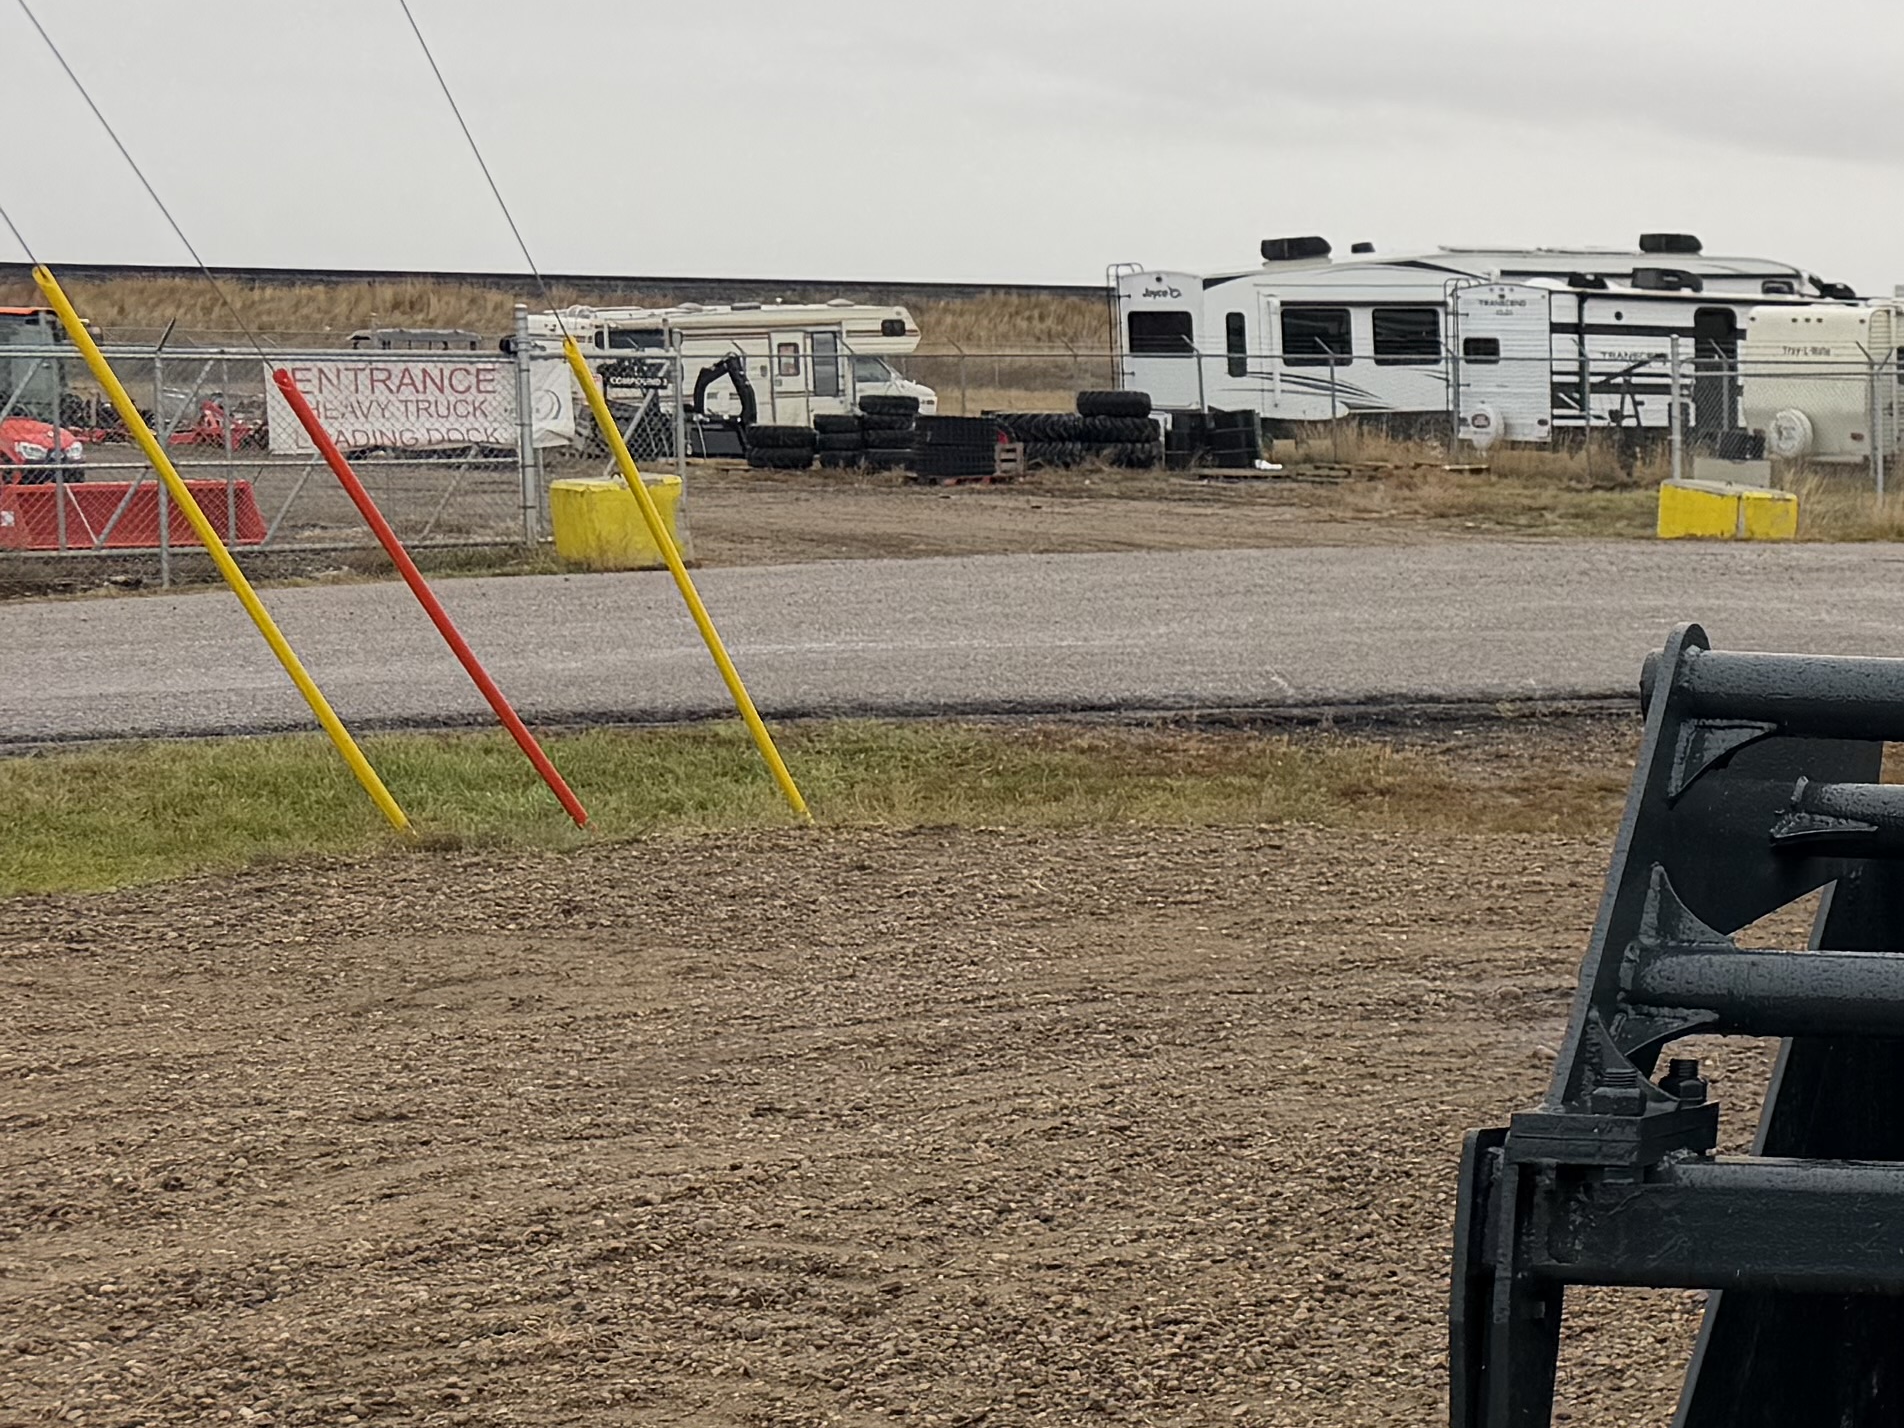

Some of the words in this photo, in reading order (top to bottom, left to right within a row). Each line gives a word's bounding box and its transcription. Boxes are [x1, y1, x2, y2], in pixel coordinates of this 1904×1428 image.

[291, 367, 497, 394] ENTRANCE
[398, 398, 488, 420] TRUCK
[296, 429, 420, 448] LADING
[426, 428, 502, 445] DOCK
